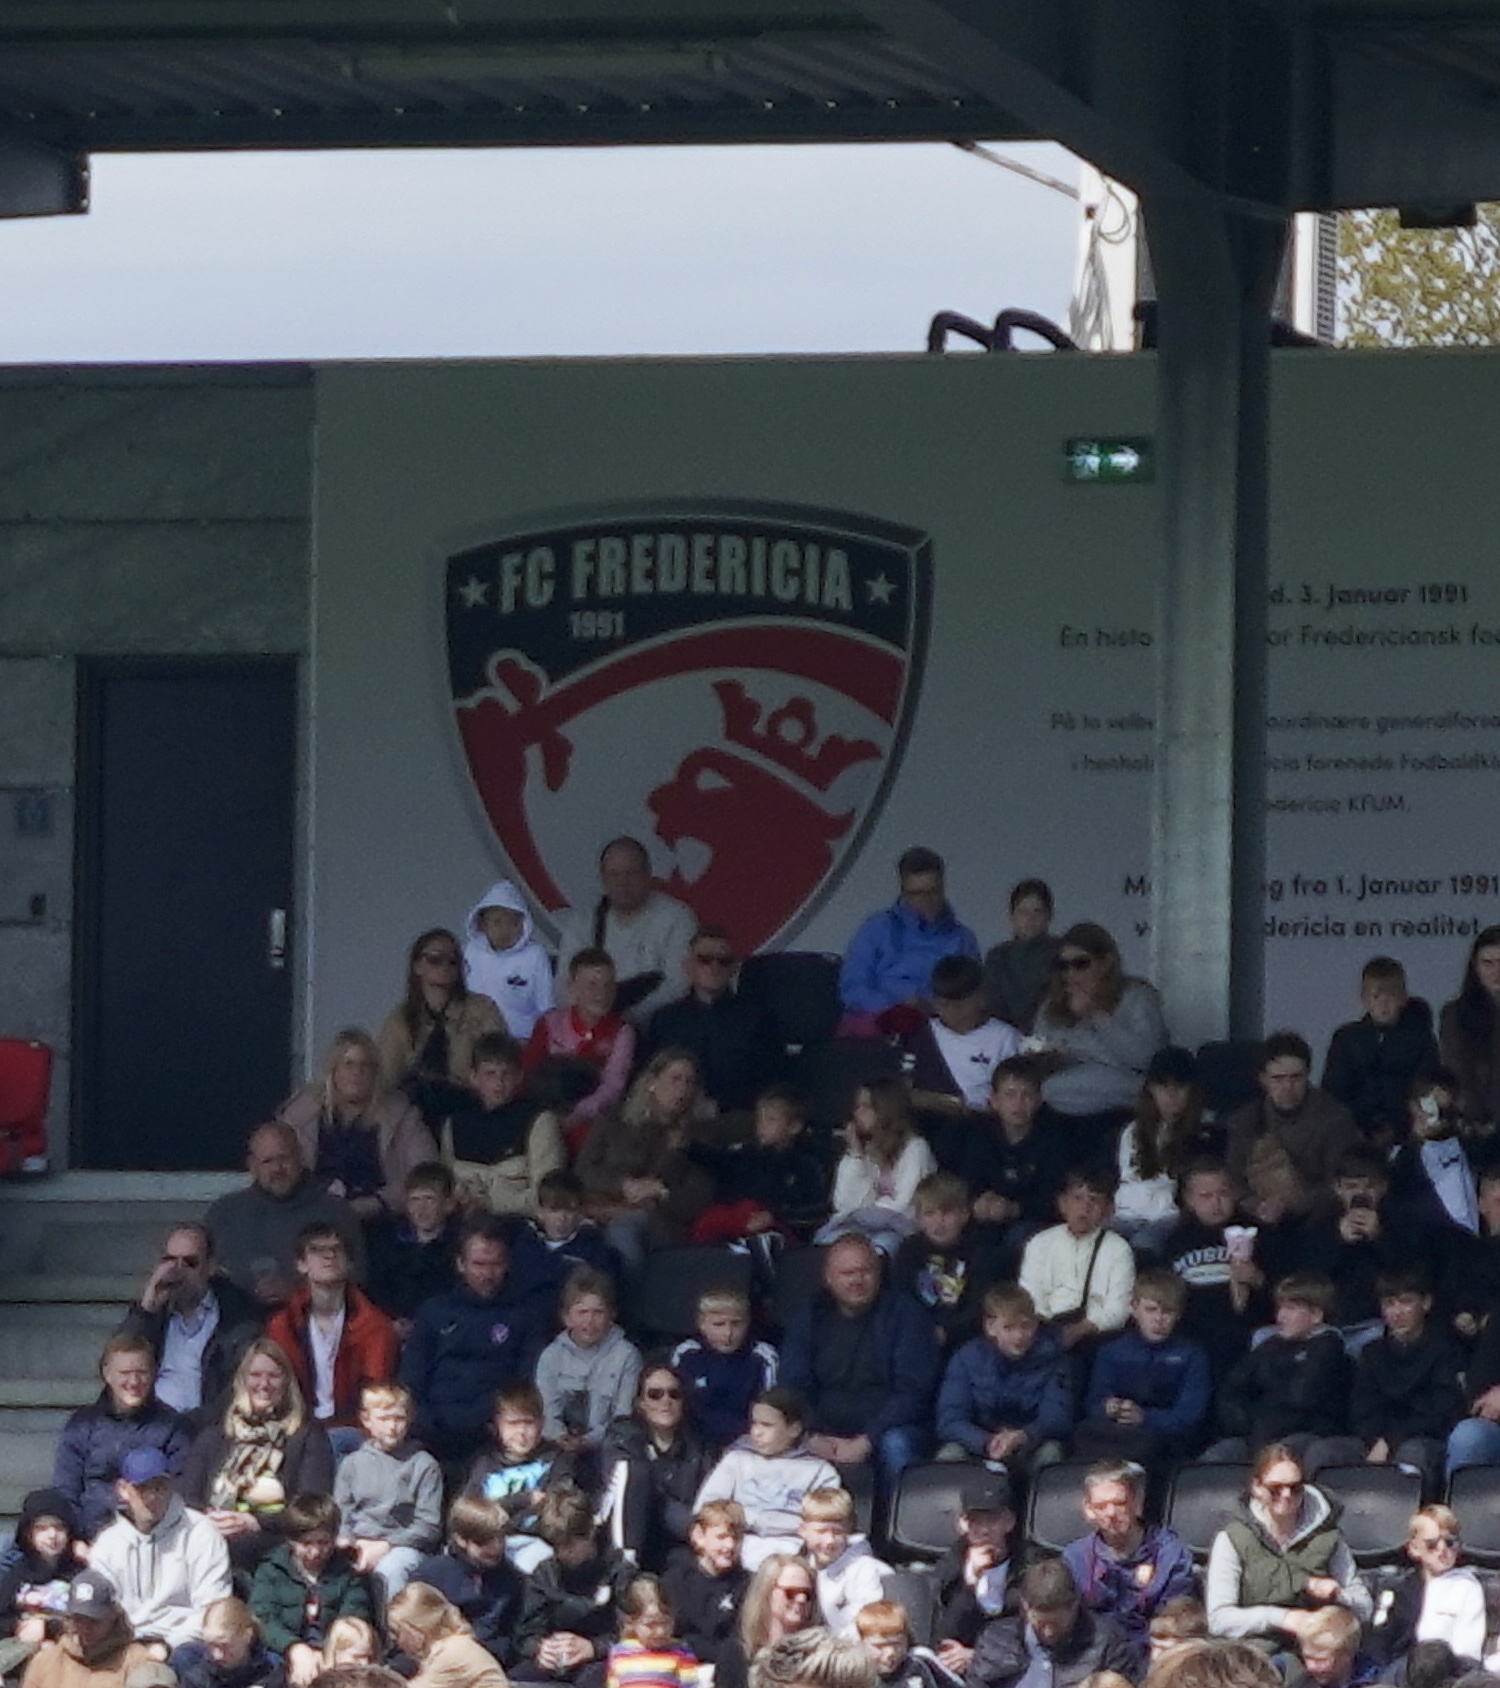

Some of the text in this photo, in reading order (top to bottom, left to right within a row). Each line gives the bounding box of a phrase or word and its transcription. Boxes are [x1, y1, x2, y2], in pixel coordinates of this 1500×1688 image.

[500, 534, 854, 612] FC FREDERICIA
[1325, 584, 1410, 611] Januar
[569, 608, 625, 640] 1991
[1094, 625, 1153, 648] histo
[1289, 873, 1327, 896] fra
[1355, 874, 1441, 900] Januar
[1449, 874, 1500, 896] 1991
[1264, 916, 1346, 938] dericia
[1354, 922, 1383, 938] en
